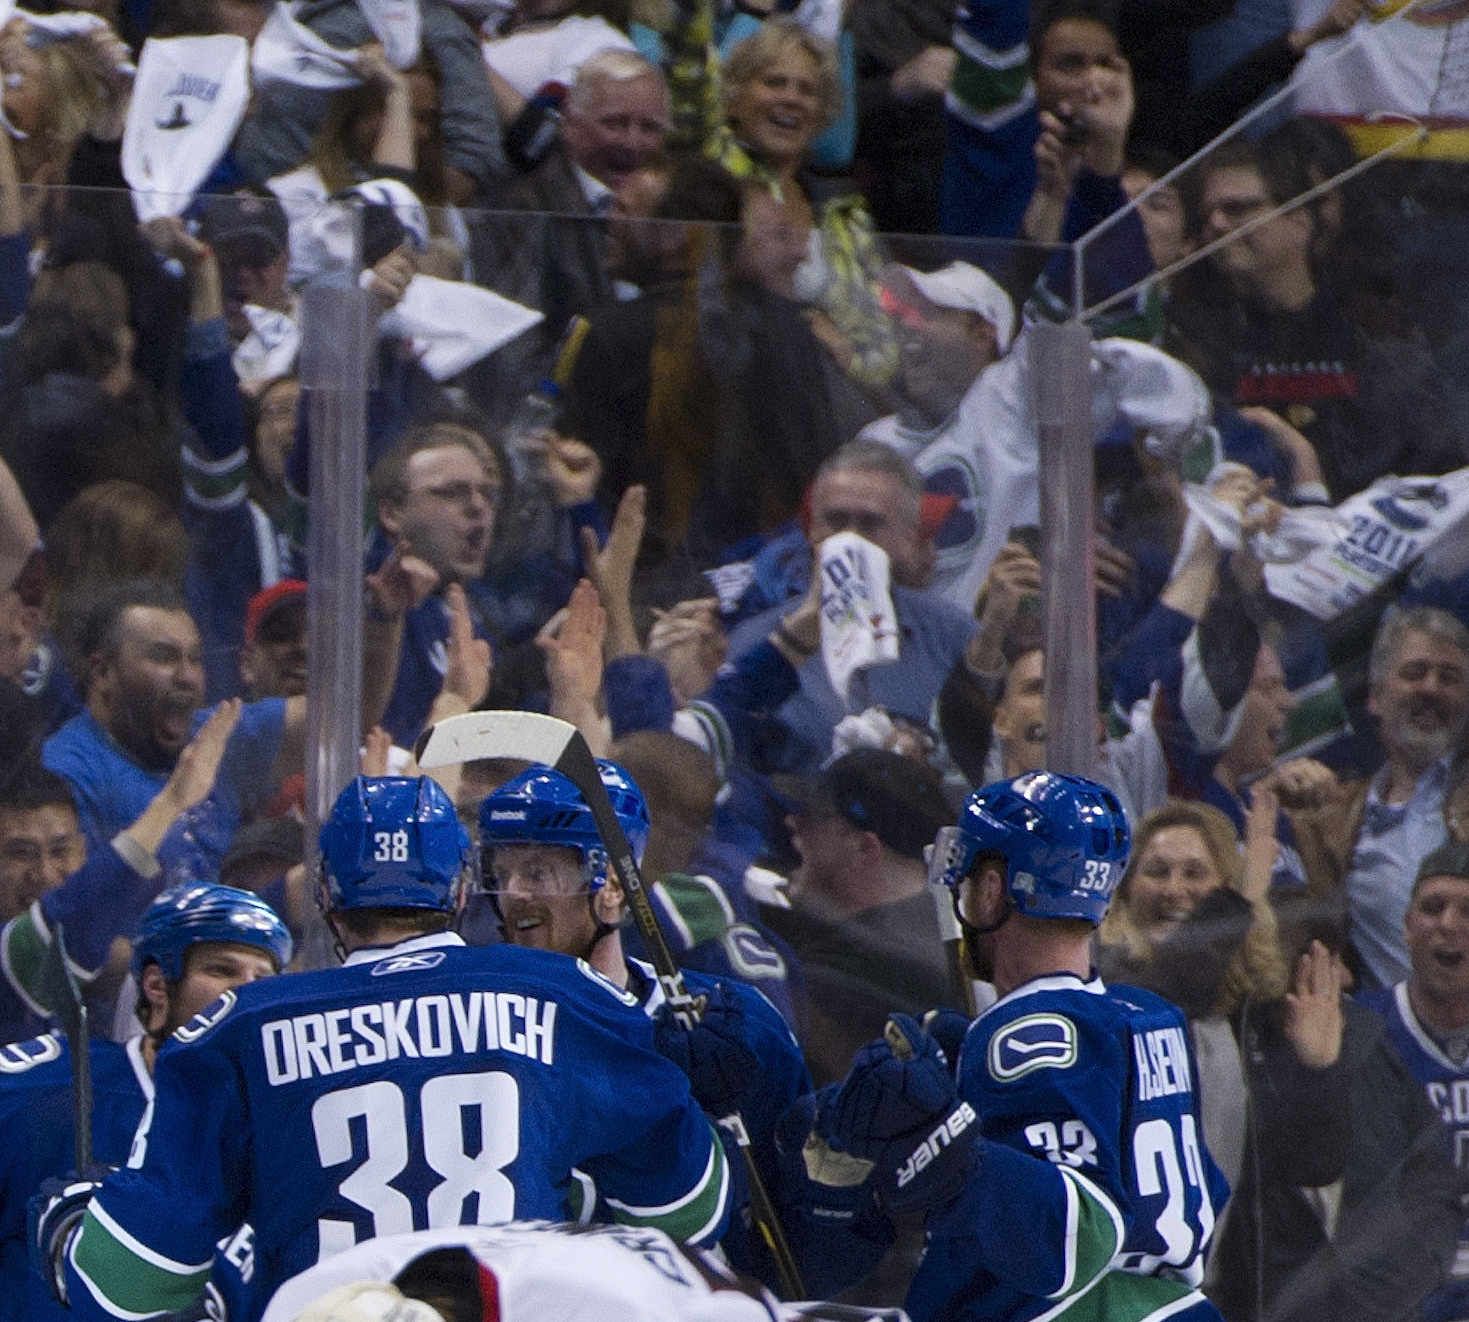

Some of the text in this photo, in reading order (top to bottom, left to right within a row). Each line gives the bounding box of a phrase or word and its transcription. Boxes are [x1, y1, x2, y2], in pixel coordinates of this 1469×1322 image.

[374, 831, 409, 862] 38
[1080, 859, 1111, 891] 33
[261, 991, 558, 1087] ORESKOVICH
[310, 1070, 520, 1262] 38
[1132, 1114, 1216, 1290] 33
